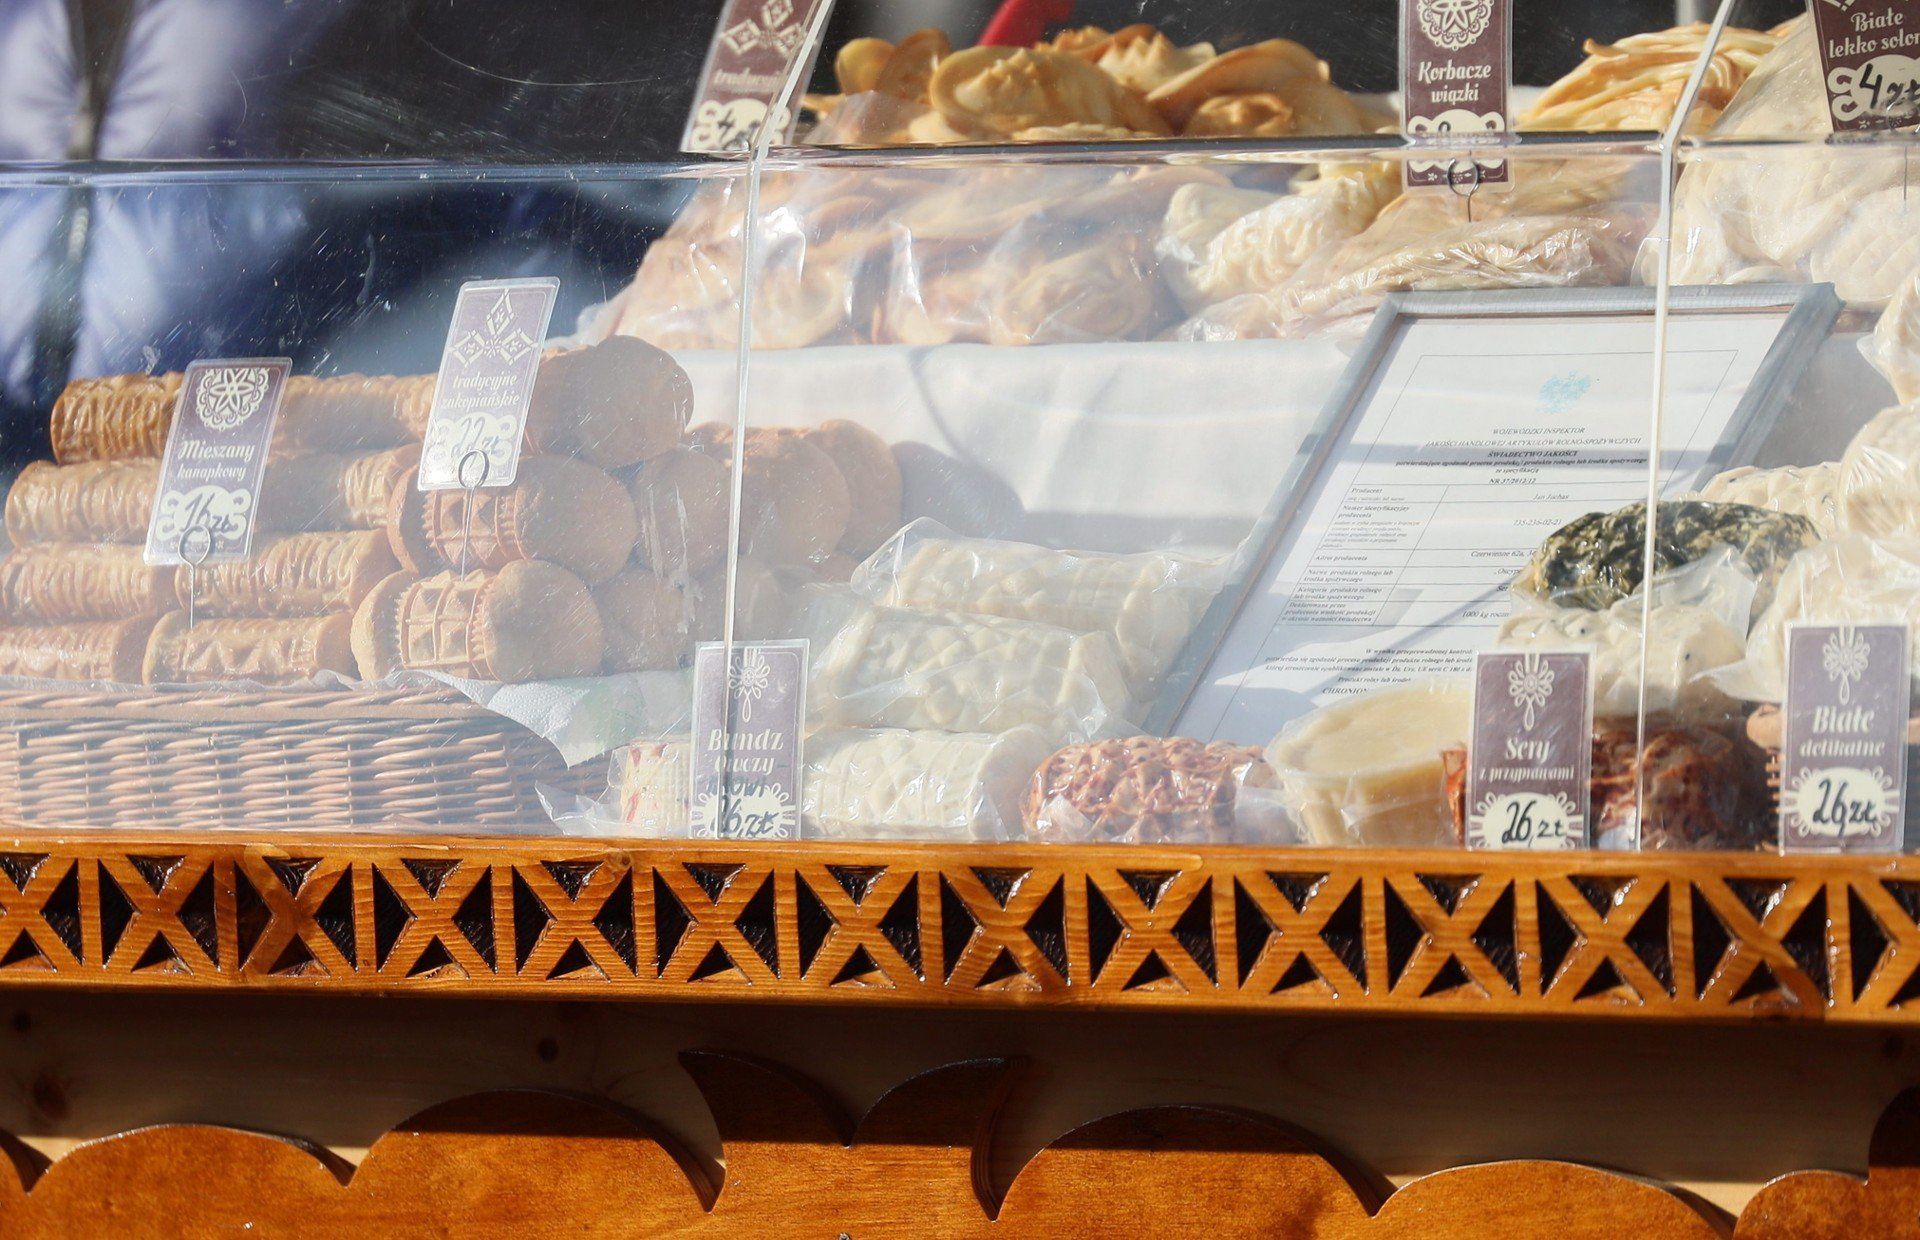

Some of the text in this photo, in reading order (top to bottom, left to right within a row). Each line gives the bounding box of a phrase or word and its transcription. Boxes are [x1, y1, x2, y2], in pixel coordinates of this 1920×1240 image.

[1850, 7, 1904, 32] Białe
[1829, 36, 1877, 58] lekko
[1418, 59, 1492, 84] Korbacze
[1431, 83, 1479, 105] wiązki
[452, 371, 518, 392] tradycyjne
[442, 388, 520, 412] zakopiańskie
[1542, 426, 1586, 434] INSPEKTOR
[178, 439, 256, 463] Mieszany
[177, 461, 247, 481] kanapkowy
[708, 728, 784, 751] Bundz
[1506, 737, 1552, 764] Sery
[1799, 739, 1885, 758] delikatne
[1488, 764, 1576, 783] przyprawami
